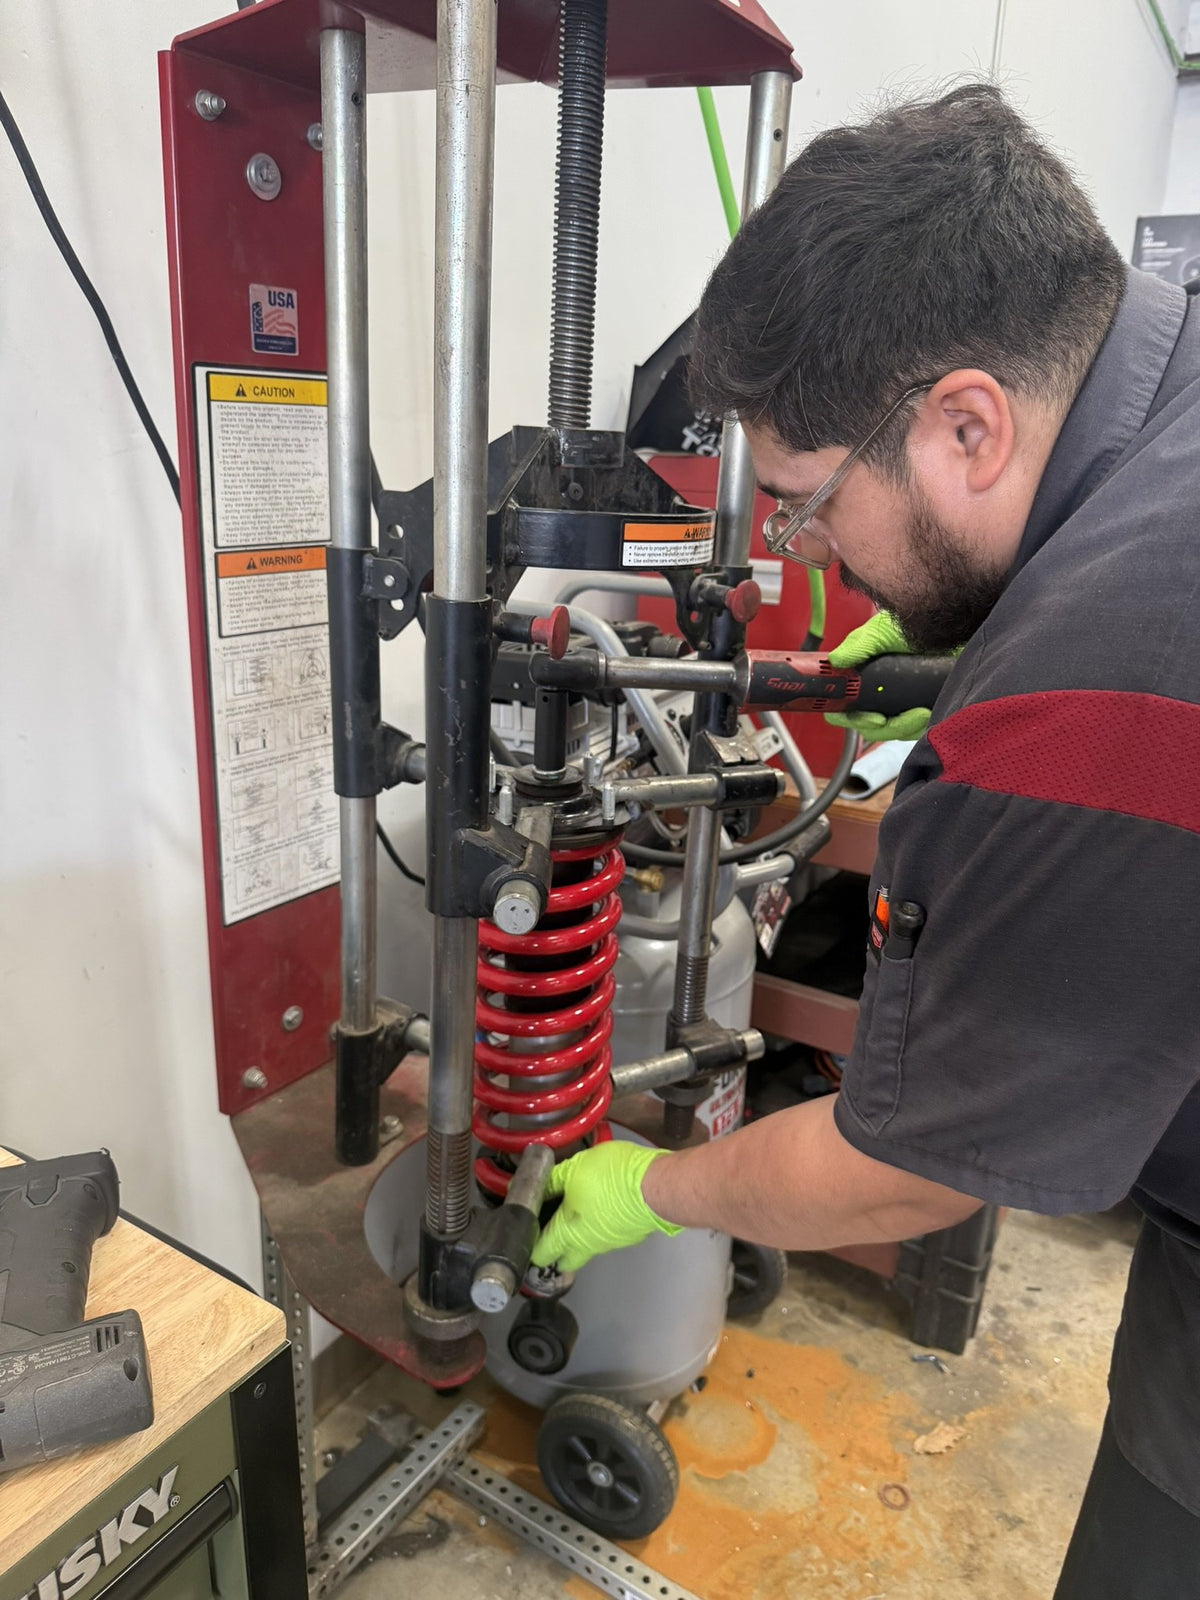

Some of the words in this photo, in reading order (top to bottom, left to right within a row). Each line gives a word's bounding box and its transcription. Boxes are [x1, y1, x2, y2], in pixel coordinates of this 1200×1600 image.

[268, 290, 295, 309] USA
[253, 386, 295, 398] CAUTION
[260, 555, 303, 566] WARNING
